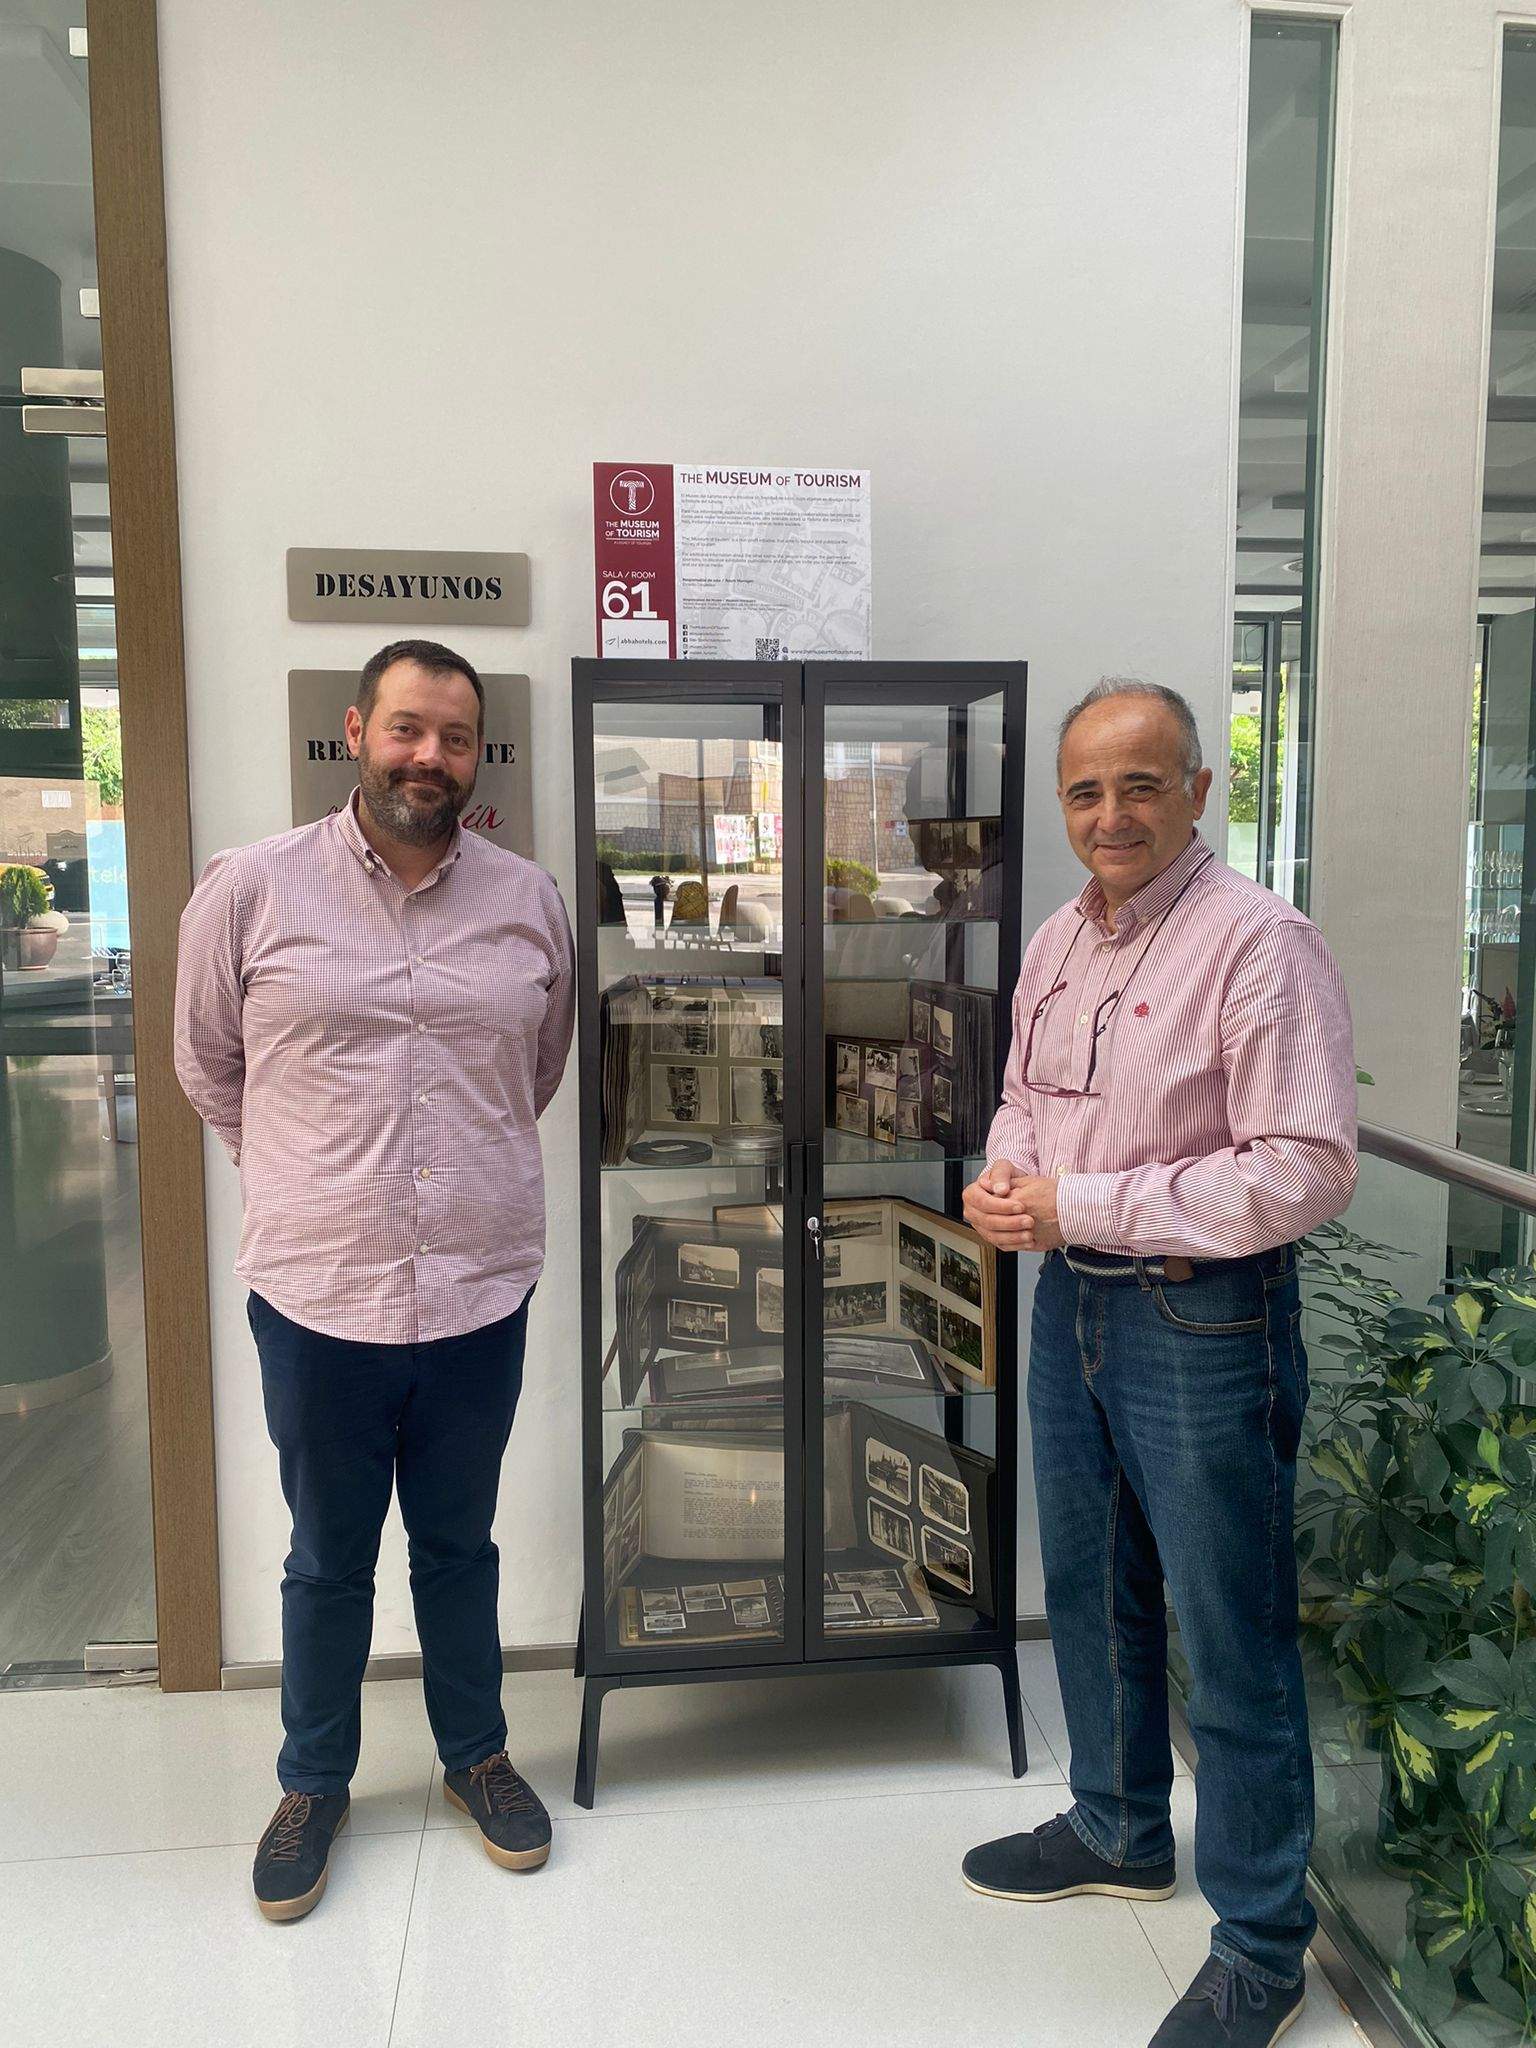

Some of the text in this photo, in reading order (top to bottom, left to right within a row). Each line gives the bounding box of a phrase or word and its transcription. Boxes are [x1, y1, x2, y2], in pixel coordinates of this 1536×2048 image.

[680, 471, 861, 487] THE MUSEUM OF TOURISM
[605, 520, 659, 529] THE MUSEUM
[616, 529, 659, 538] TOURISM
[602, 571, 623, 579] SALA
[631, 572, 656, 580] ROOM
[316, 573, 502, 600] DESAYUNOS
[602, 581, 658, 619] 61
[620, 637, 667, 645] abbahotels.com
